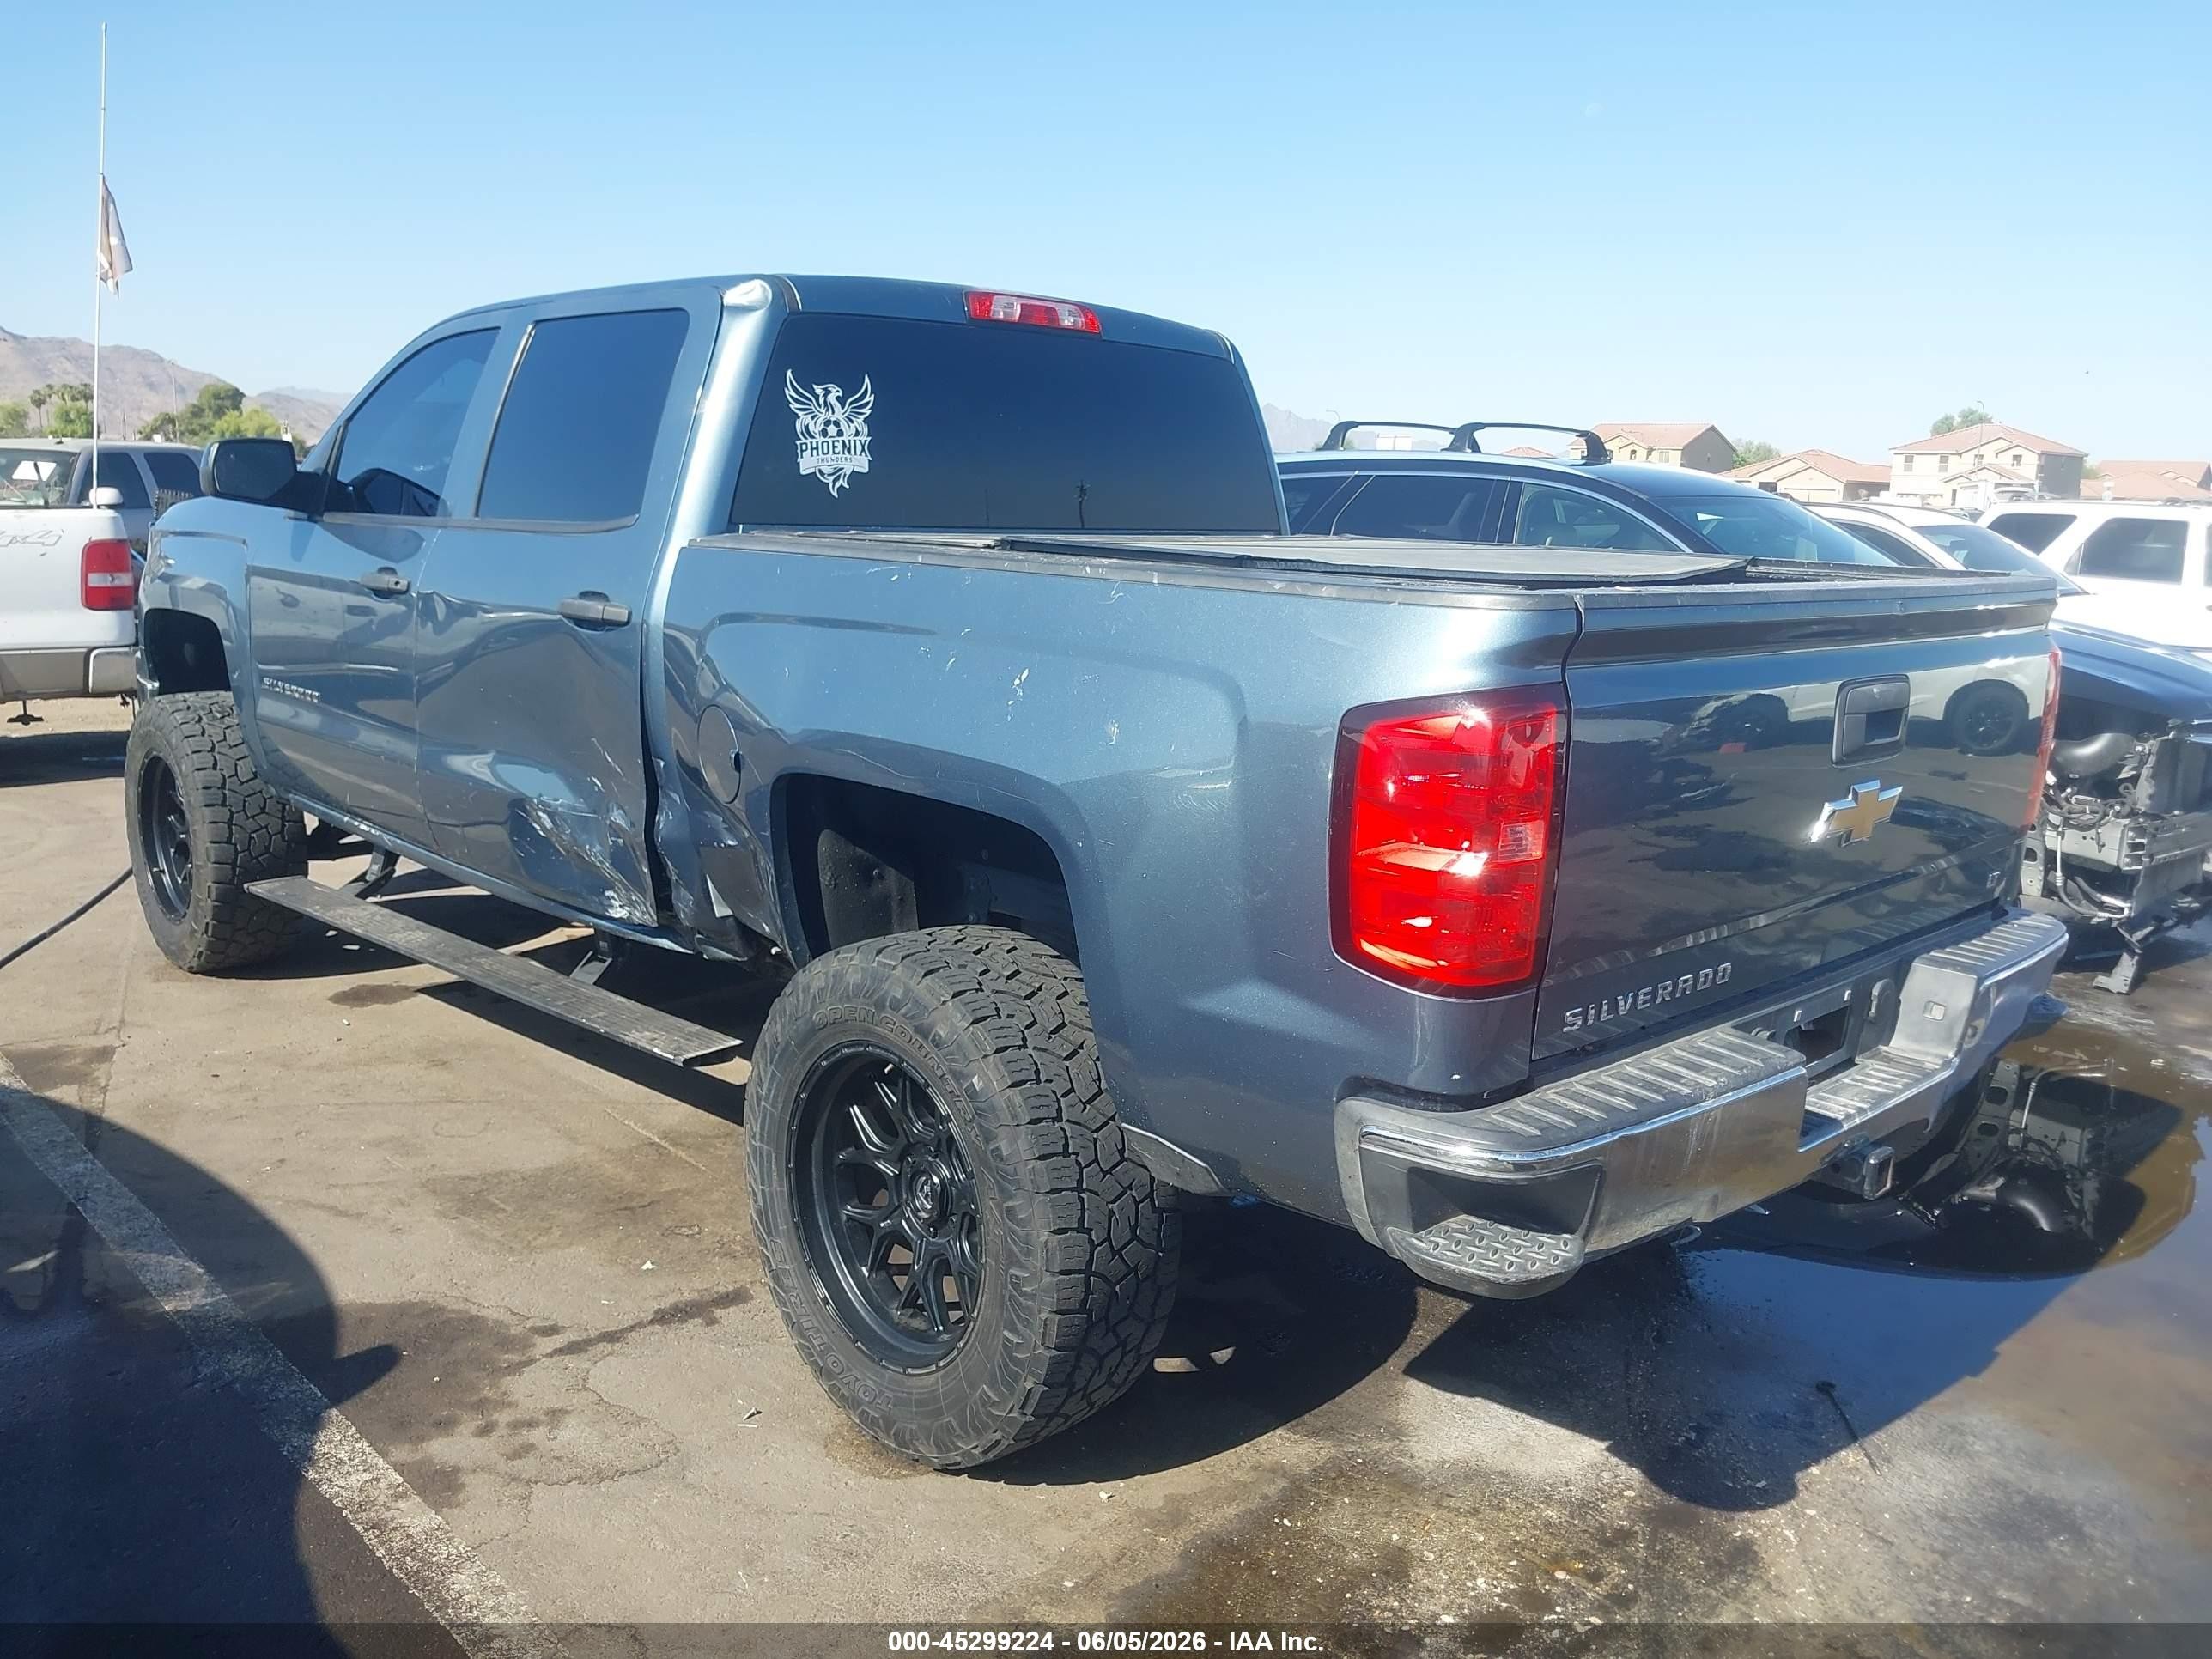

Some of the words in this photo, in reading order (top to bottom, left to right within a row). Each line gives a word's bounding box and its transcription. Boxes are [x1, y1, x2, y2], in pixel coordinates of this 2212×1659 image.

[799, 439, 869, 459] PHOENIX
[817, 456, 853, 465] THUNDERS
[1563, 962, 1732, 1032] SILVERADO
[812, 1005, 877, 1030] OPEN
[824, 1352, 895, 1413] TOYO
